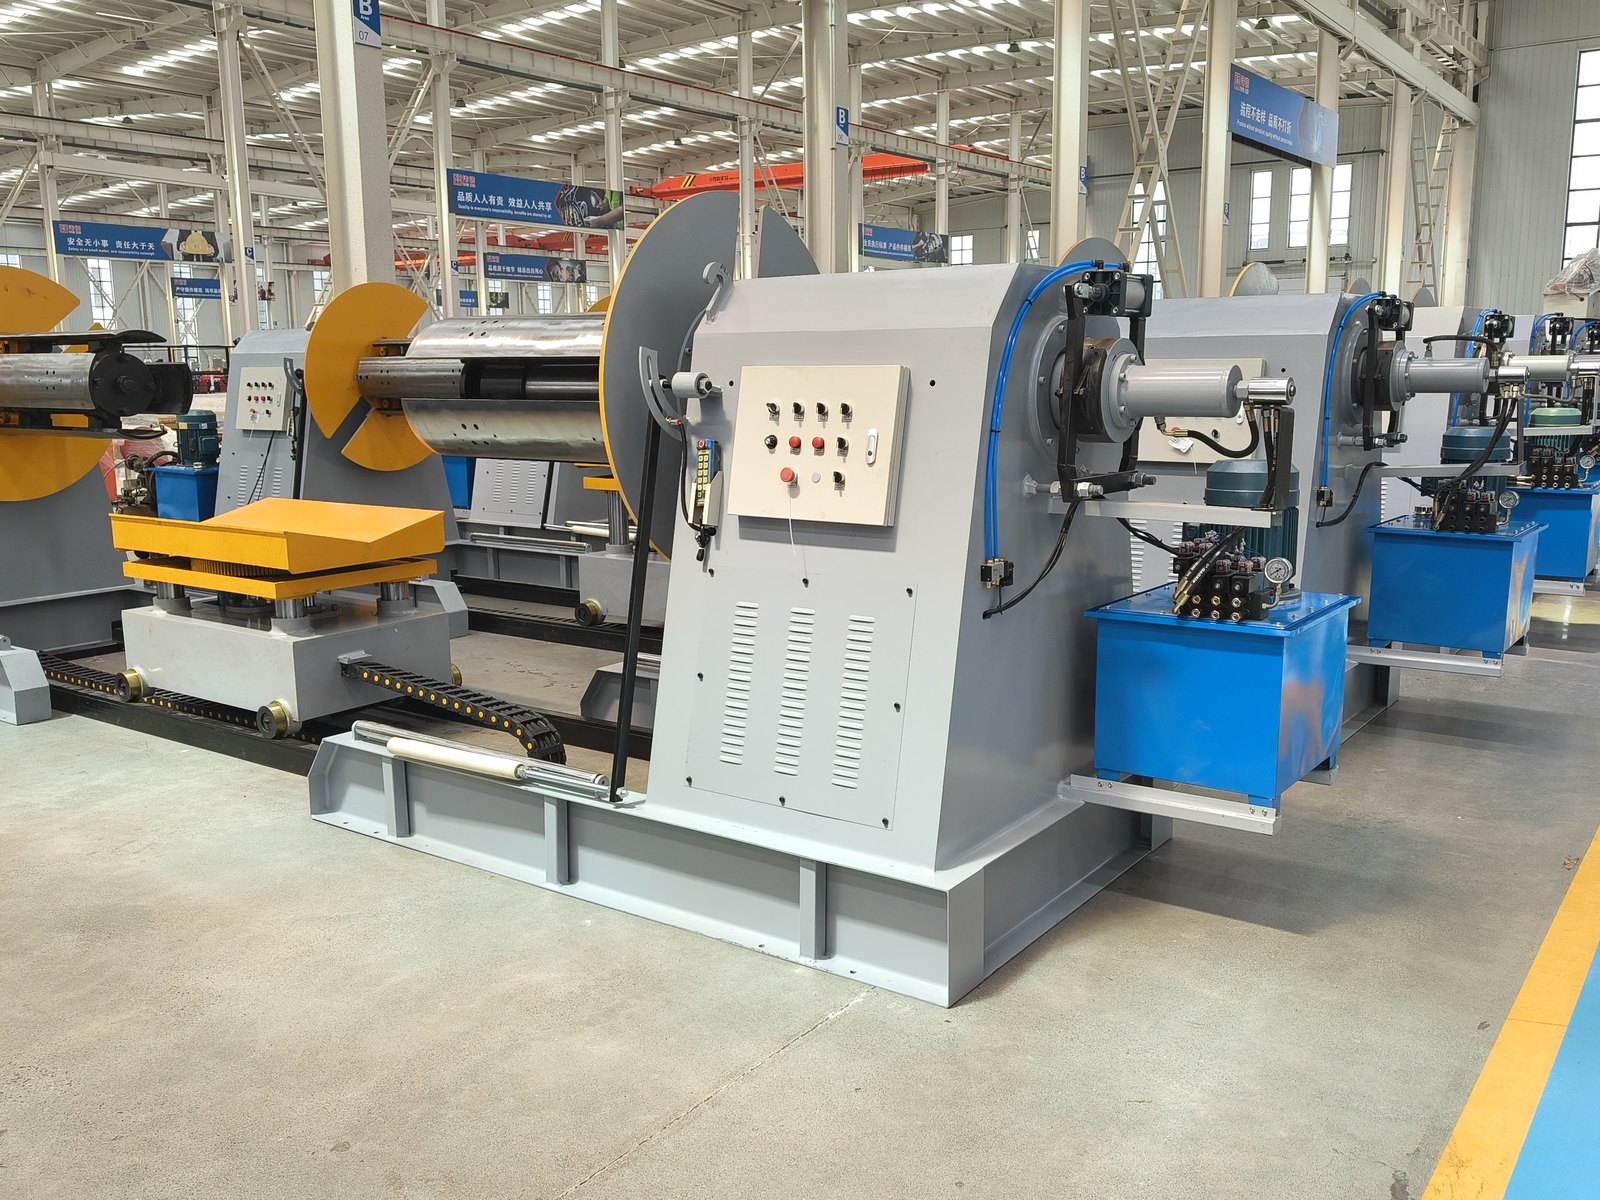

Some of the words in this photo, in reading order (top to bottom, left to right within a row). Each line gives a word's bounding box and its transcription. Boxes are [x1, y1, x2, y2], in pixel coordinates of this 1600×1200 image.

[359, 0, 372, 15] B
[359, 31, 368, 40] 07
[839, 109, 846, 124] B
[1240, 101, 1266, 125] 流程不走样
[1268, 112, 1291, 135] 品质不打折
[1080, 167, 1085, 179] B
[457, 191, 504, 207] 品质人人有责
[508, 197, 552, 212] 效益人人共享
[67, 237, 109, 248] 安全无小事
[115, 240, 155, 251] 责任大于天
